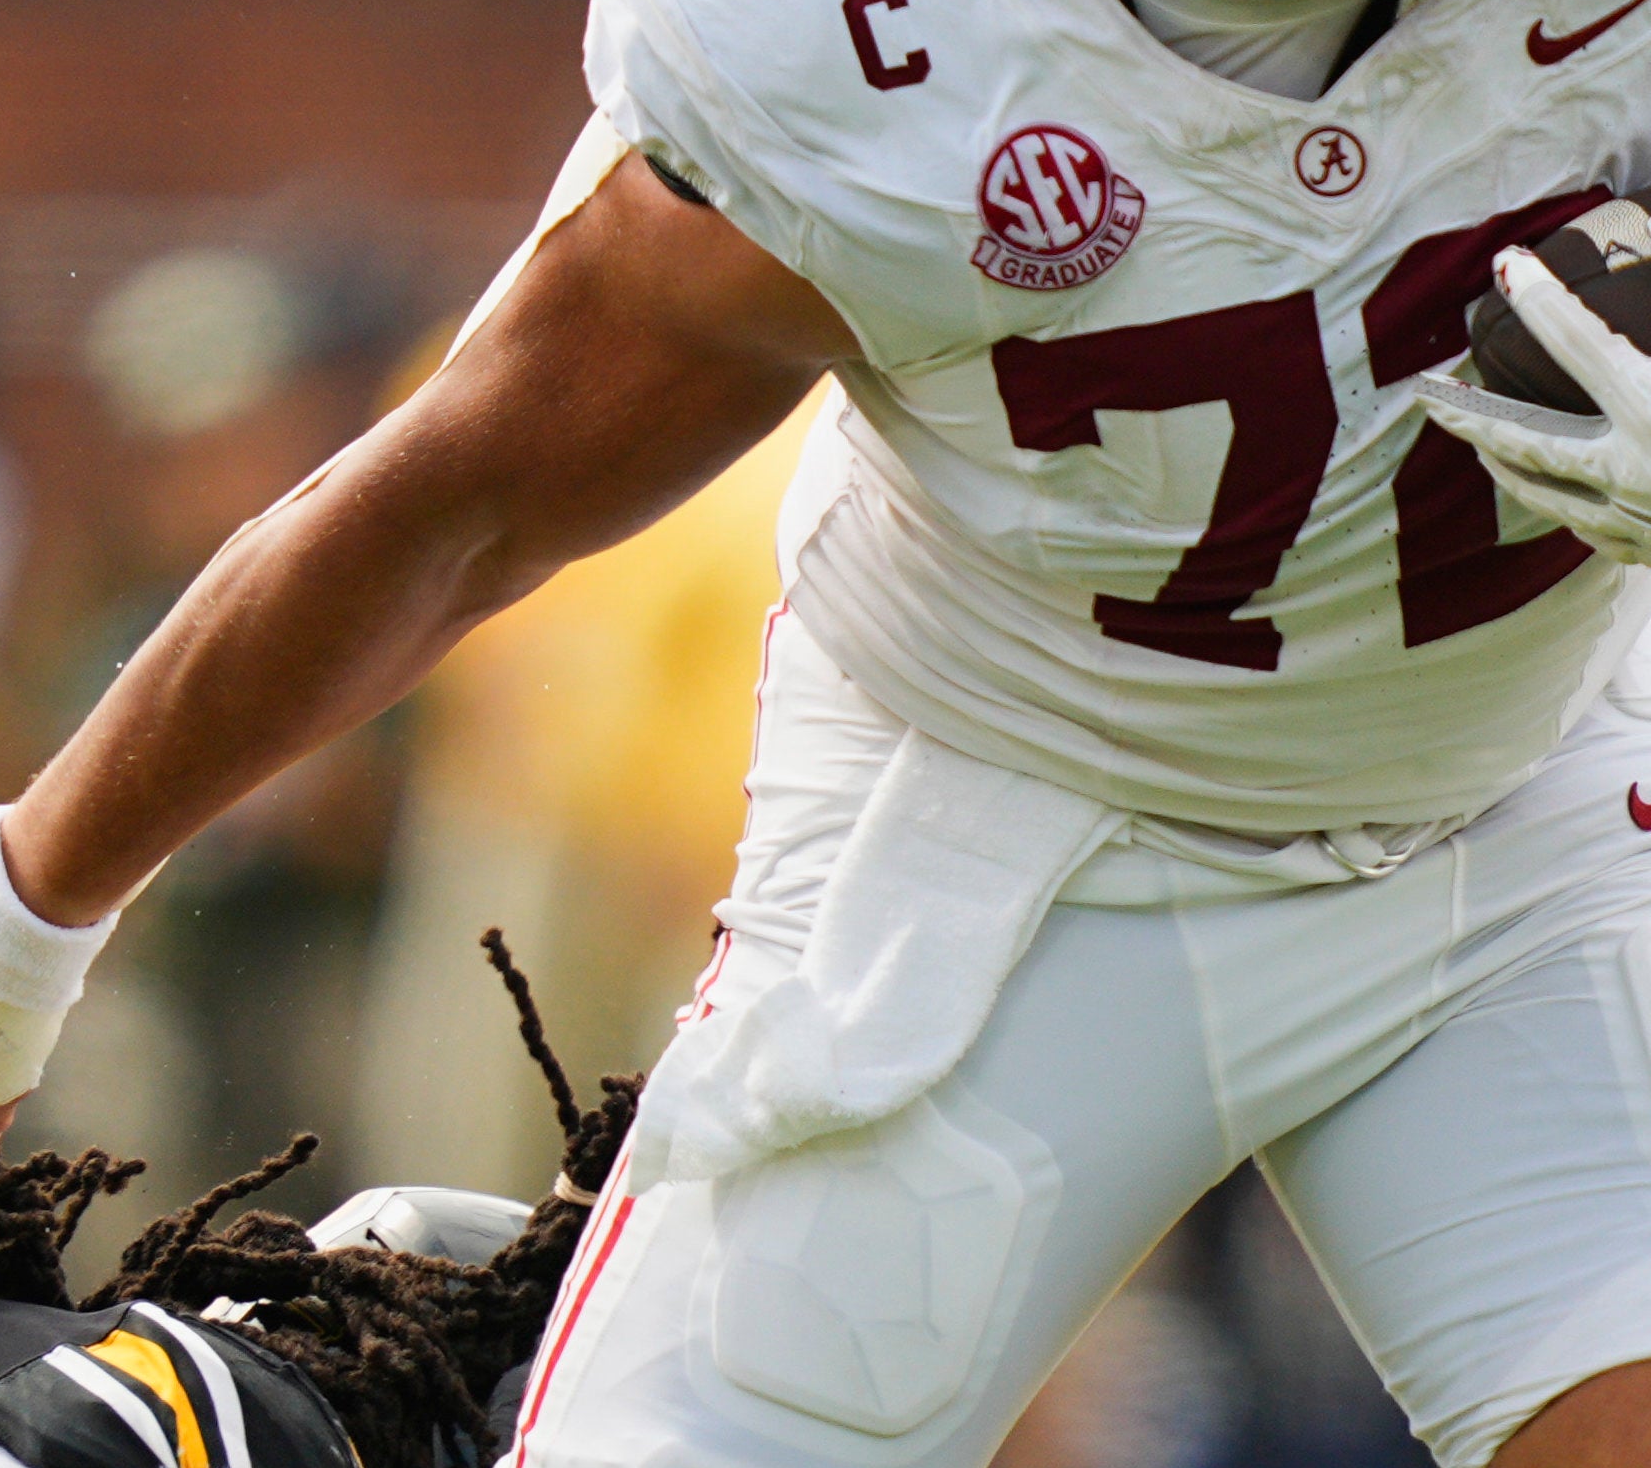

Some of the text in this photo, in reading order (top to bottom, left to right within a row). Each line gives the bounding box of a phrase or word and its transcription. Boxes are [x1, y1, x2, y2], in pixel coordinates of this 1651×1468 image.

[988, 132, 1102, 250] SEC
[1000, 208, 1138, 288] GRADUATE
[991, 184, 1613, 672] 72
